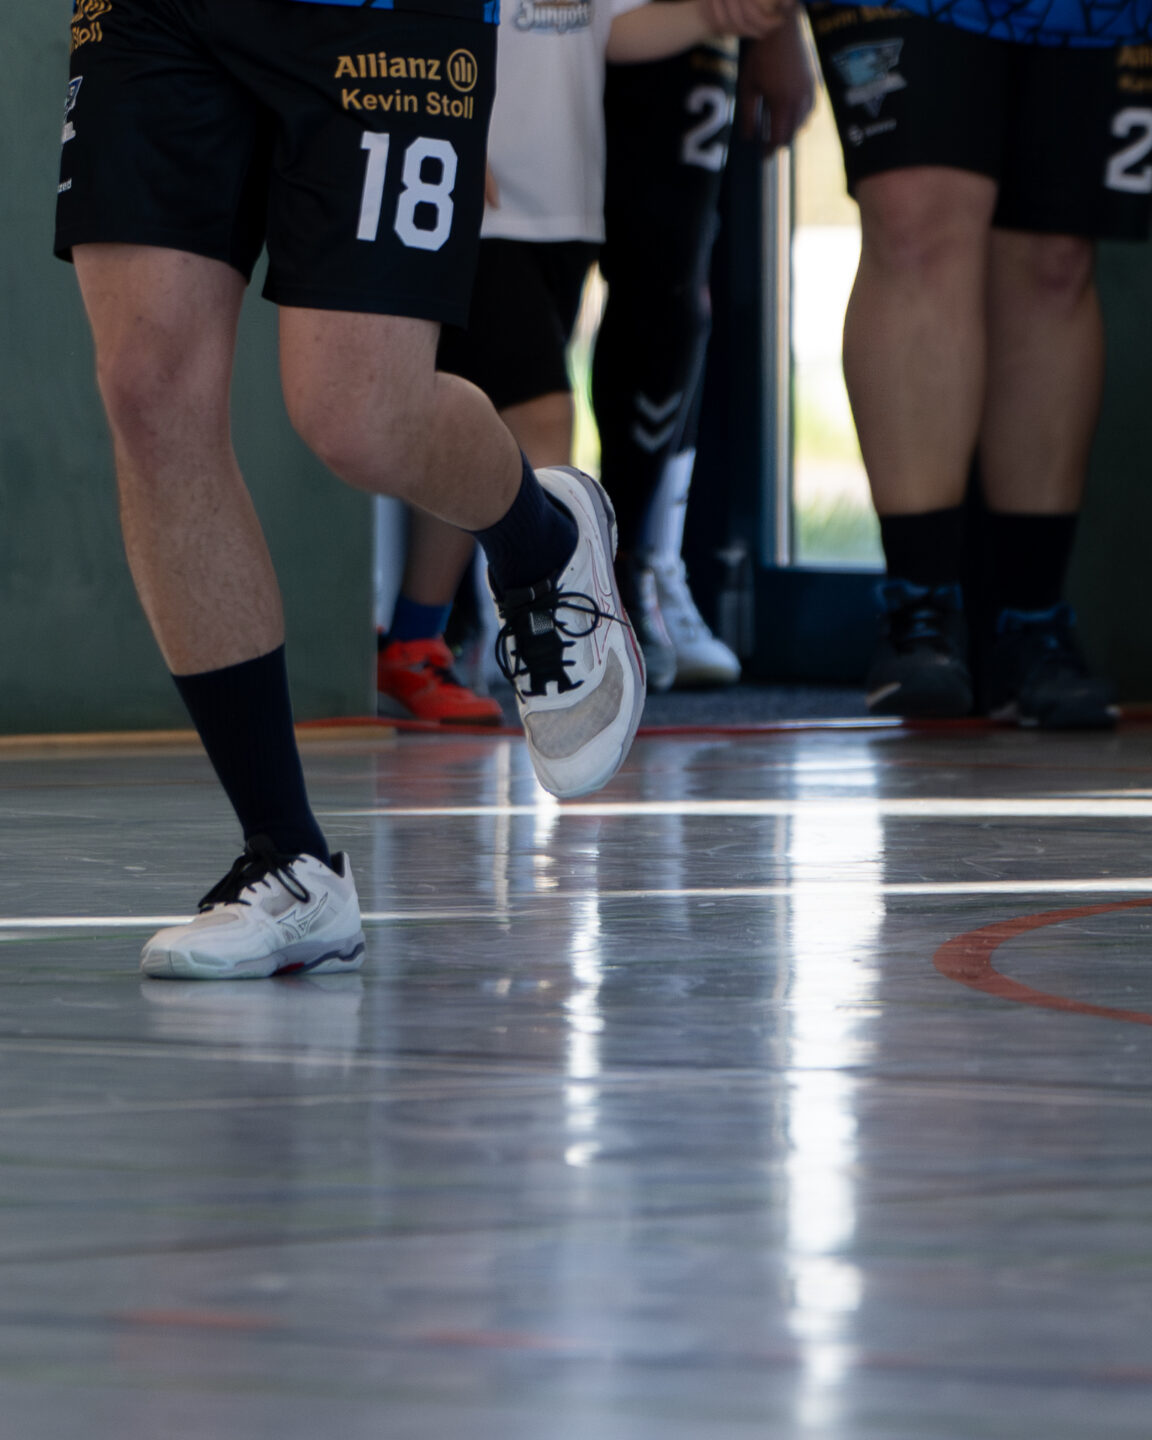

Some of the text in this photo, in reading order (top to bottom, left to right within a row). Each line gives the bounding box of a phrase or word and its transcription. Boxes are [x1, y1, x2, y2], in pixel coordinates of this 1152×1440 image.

[334, 51, 442, 81] Allianz
[341, 88, 474, 120] Kevin Stoll
[356, 130, 459, 252] 18
